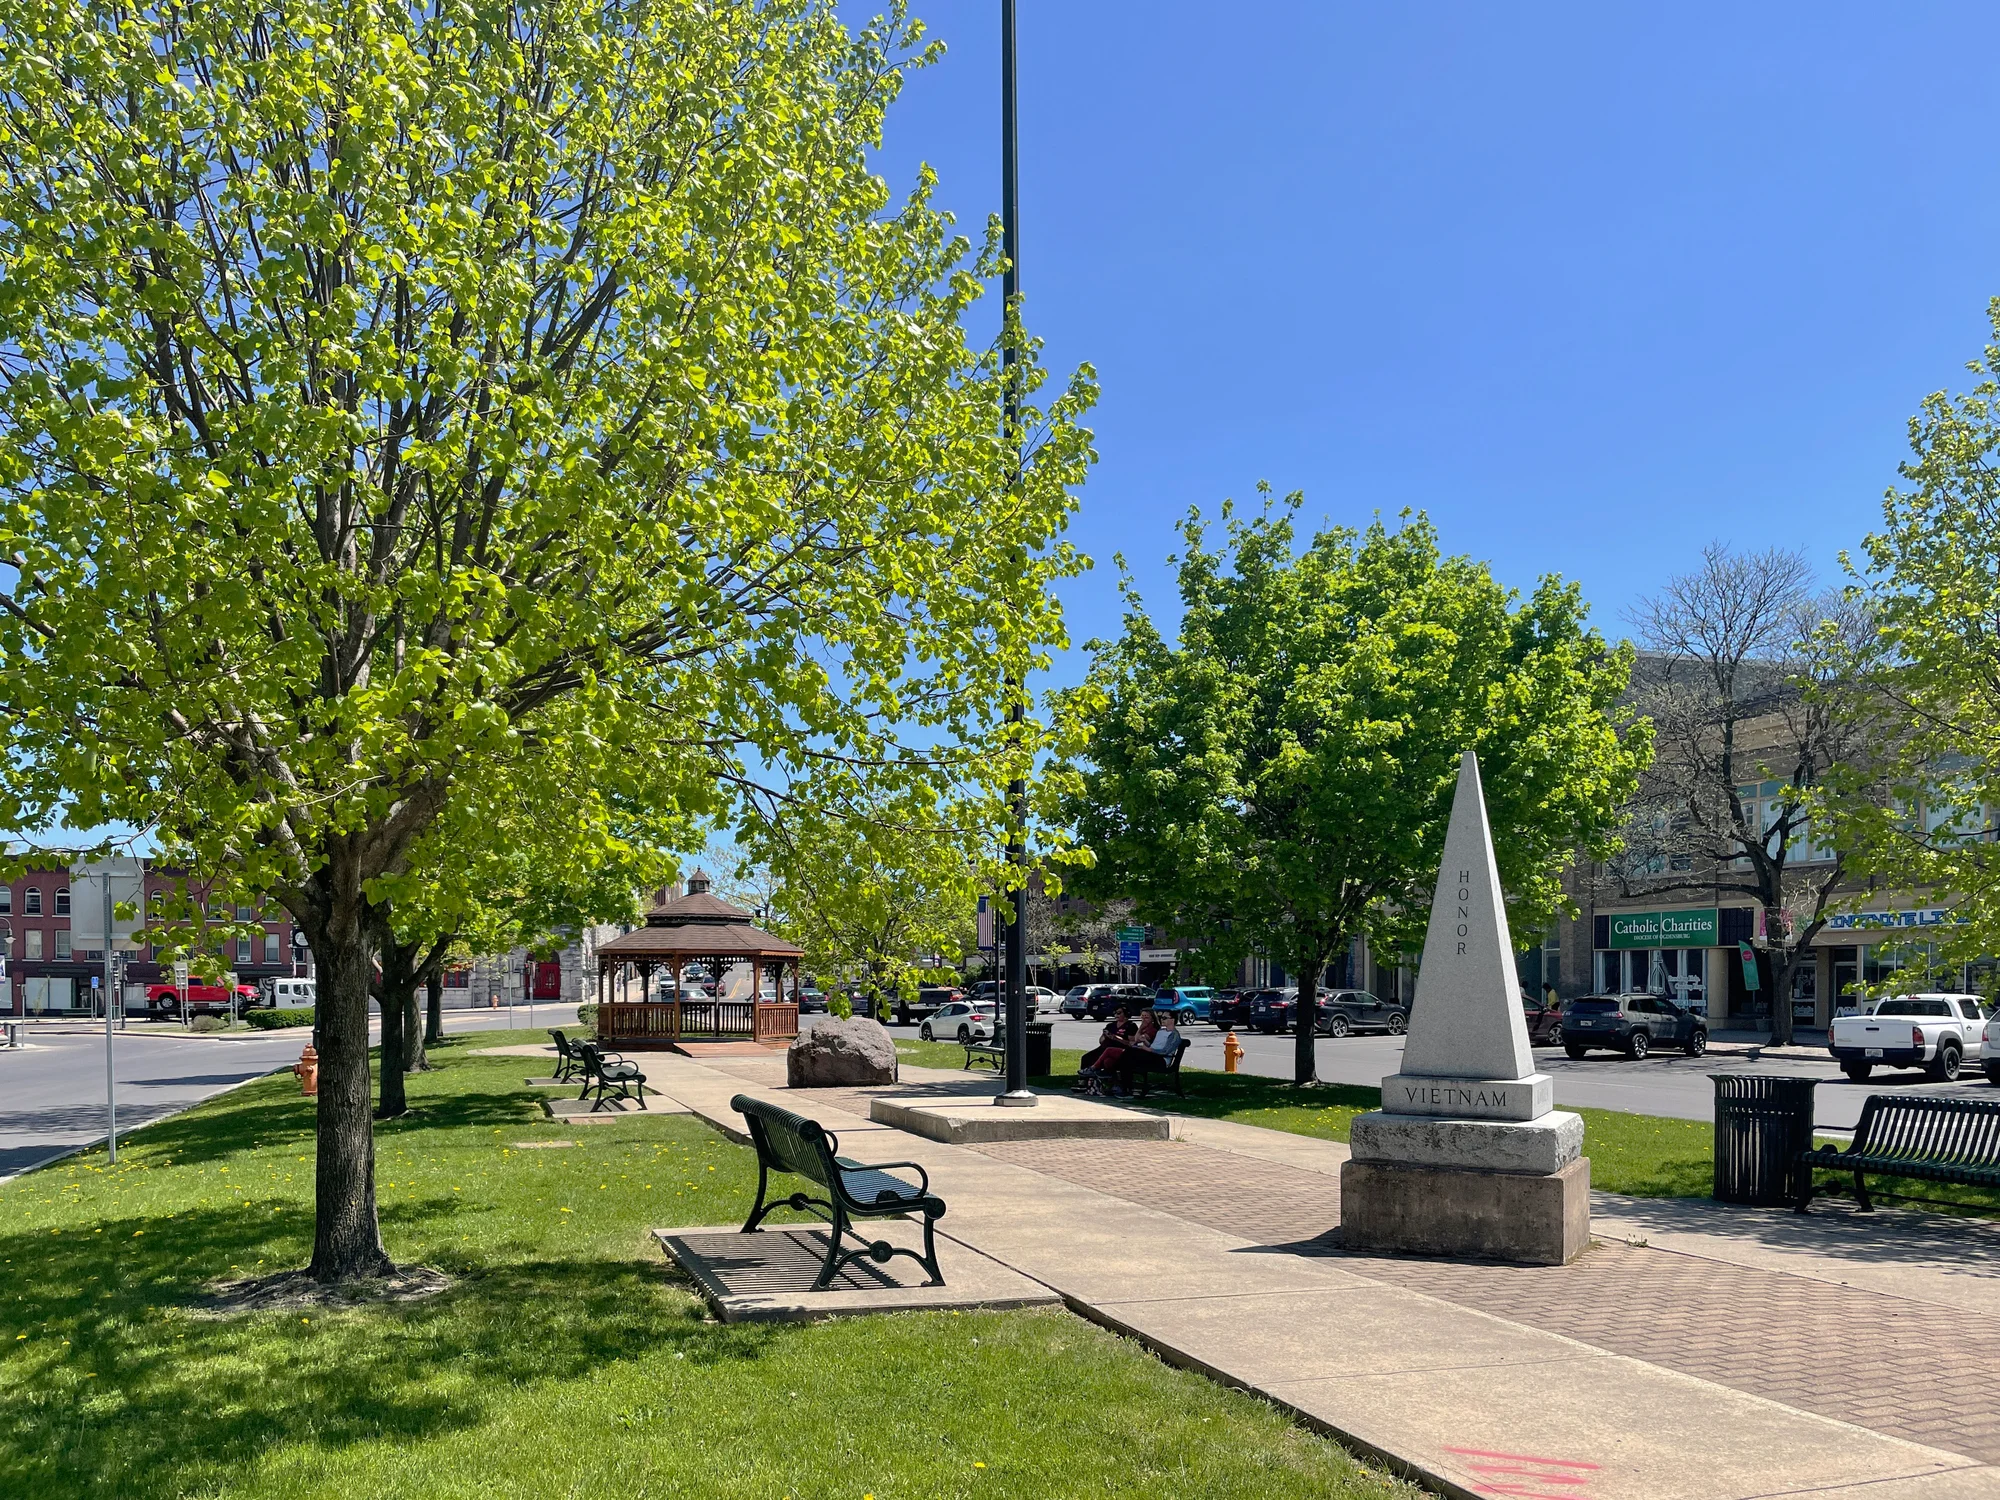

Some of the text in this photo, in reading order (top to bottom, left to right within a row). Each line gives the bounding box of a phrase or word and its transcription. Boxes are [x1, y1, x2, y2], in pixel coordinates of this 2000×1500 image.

[1457, 871, 1469, 954] HONOR
[1615, 918, 1713, 934] Catholic Charities
[1405, 1087, 1507, 1107] VIETNAM
